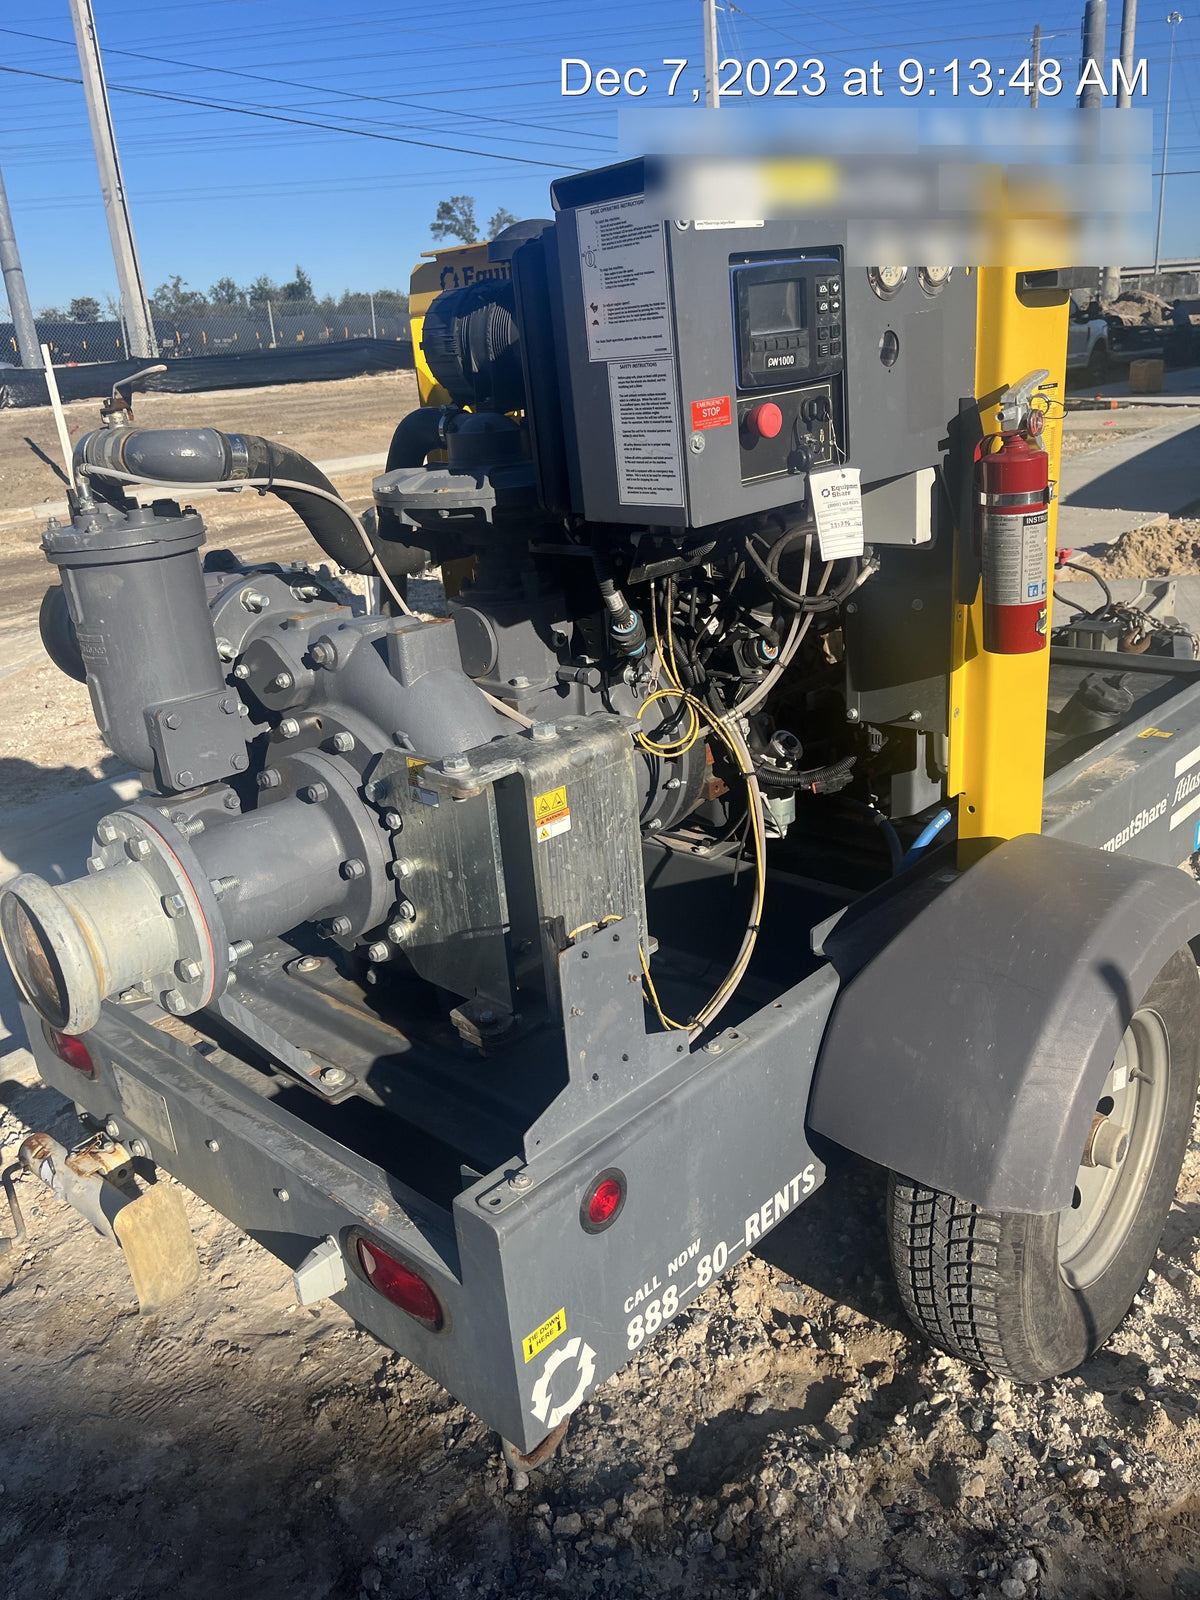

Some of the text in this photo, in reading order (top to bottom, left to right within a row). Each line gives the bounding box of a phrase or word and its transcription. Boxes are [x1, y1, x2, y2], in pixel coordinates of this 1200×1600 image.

[621, 199, 645, 210] INSTRUCTION
[696, 399, 725, 408] EMERGENCY
[702, 406, 721, 418] STOP
[624, 1238, 701, 1314] CALL NOW
[528, 1314, 560, 1343] TIE DOWN
[536, 1328, 554, 1346] HERE
